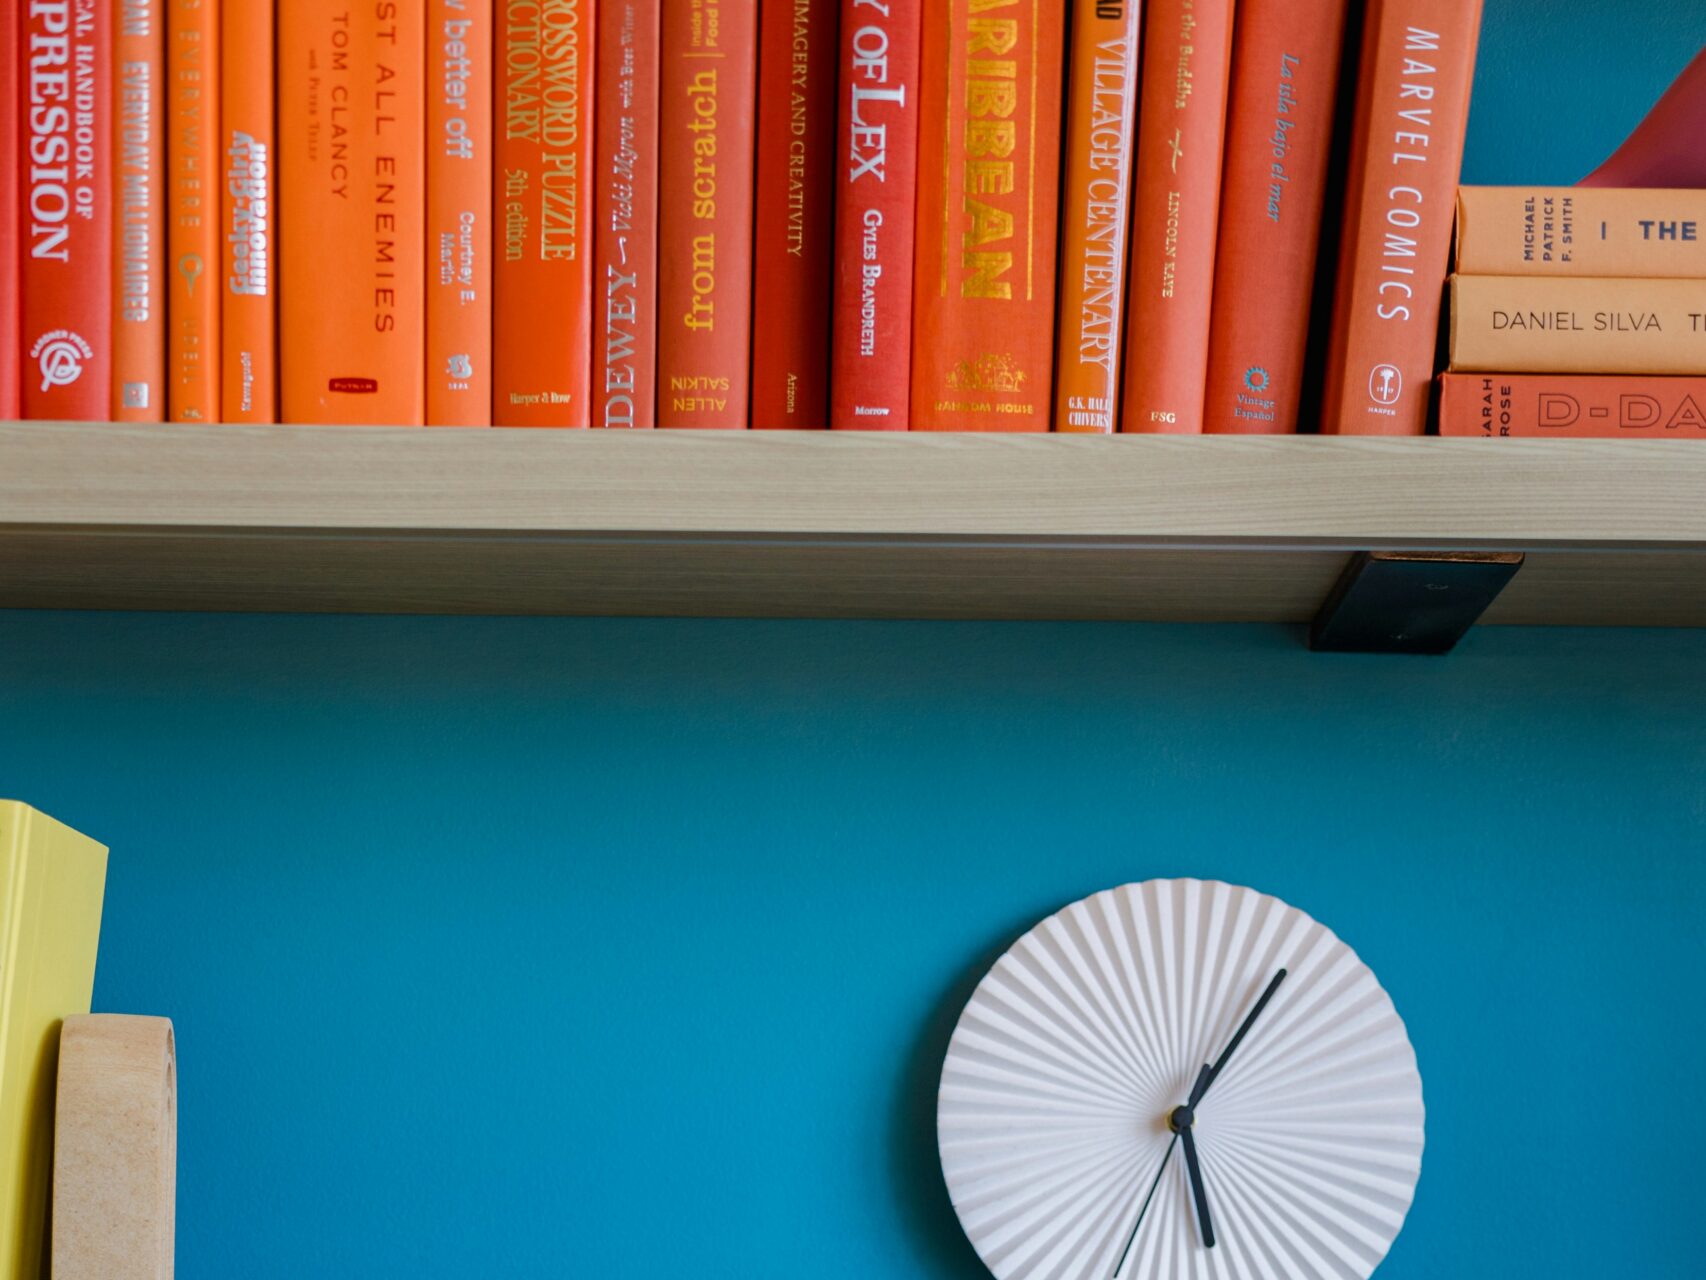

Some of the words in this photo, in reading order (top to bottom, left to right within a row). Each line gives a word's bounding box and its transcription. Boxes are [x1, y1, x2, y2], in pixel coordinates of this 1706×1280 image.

[332, 13, 348, 71] TOM
[446, 20, 472, 110] better
[852, 26, 889, 83] OF
[1281, 53, 1299, 78] La
[75, 45, 94, 180] HANDBOOK
[123, 61, 149, 170] EVERYDAY
[375, 64, 396, 136] ALL
[789, 94, 806, 135] AND
[1090, 36, 1128, 171] VILLAGE
[1278, 83, 1297, 114] isla
[1392, 26, 1441, 165] MARVEL
[30, 0, 69, 263] PRESSION
[331, 85, 349, 200] CLANCY
[446, 118, 472, 159] off
[614, 116, 639, 179] Myron
[688, 68, 716, 220] scratch
[850, 84, 905, 183] LEX
[1270, 118, 1295, 158] bajo
[506, 169, 528, 197] 5th
[787, 141, 805, 258] CREATIVITY
[1271, 164, 1289, 182] el
[75, 187, 94, 219] OF
[229, 131, 254, 295] Geeky-Girly
[248, 143, 267, 296] Innovation
[506, 203, 528, 262] edition
[541, 152, 576, 261] PUZZLE
[612, 180, 633, 232] Vicki
[1267, 187, 1281, 223] mar
[1524, 197, 1535, 261] MICHAEL
[1543, 197, 1554, 261] PATRICK
[1562, 198, 1572, 243] SMITH
[1639, 221, 1697, 240] THE
[123, 175, 149, 322] MILLIONAIRES
[375, 157, 395, 333] ENEMIES
[441, 233, 454, 285] Martin
[459, 212, 475, 287] Courtney
[862, 209, 883, 261] GYLES
[1377, 185, 1423, 322] COMICS
[684, 233, 715, 331] from
[1079, 178, 1123, 369] CENTENARY
[860, 264, 882, 357] BRANDRETH
[1493, 311, 1584, 331] DANIEL
[1594, 312, 1662, 332] SILVA
[605, 264, 637, 428] DEWEY
[672, 377, 729, 391] SALKIN
[673, 398, 726, 412] ALLEN
[1235, 406, 1275, 421] Español
[1237, 393, 1275, 409] Vintage
[1500, 385, 1511, 437] ROSE
[1069, 412, 1109, 427] CHIVERS
[1150, 411, 1176, 424] FSG
